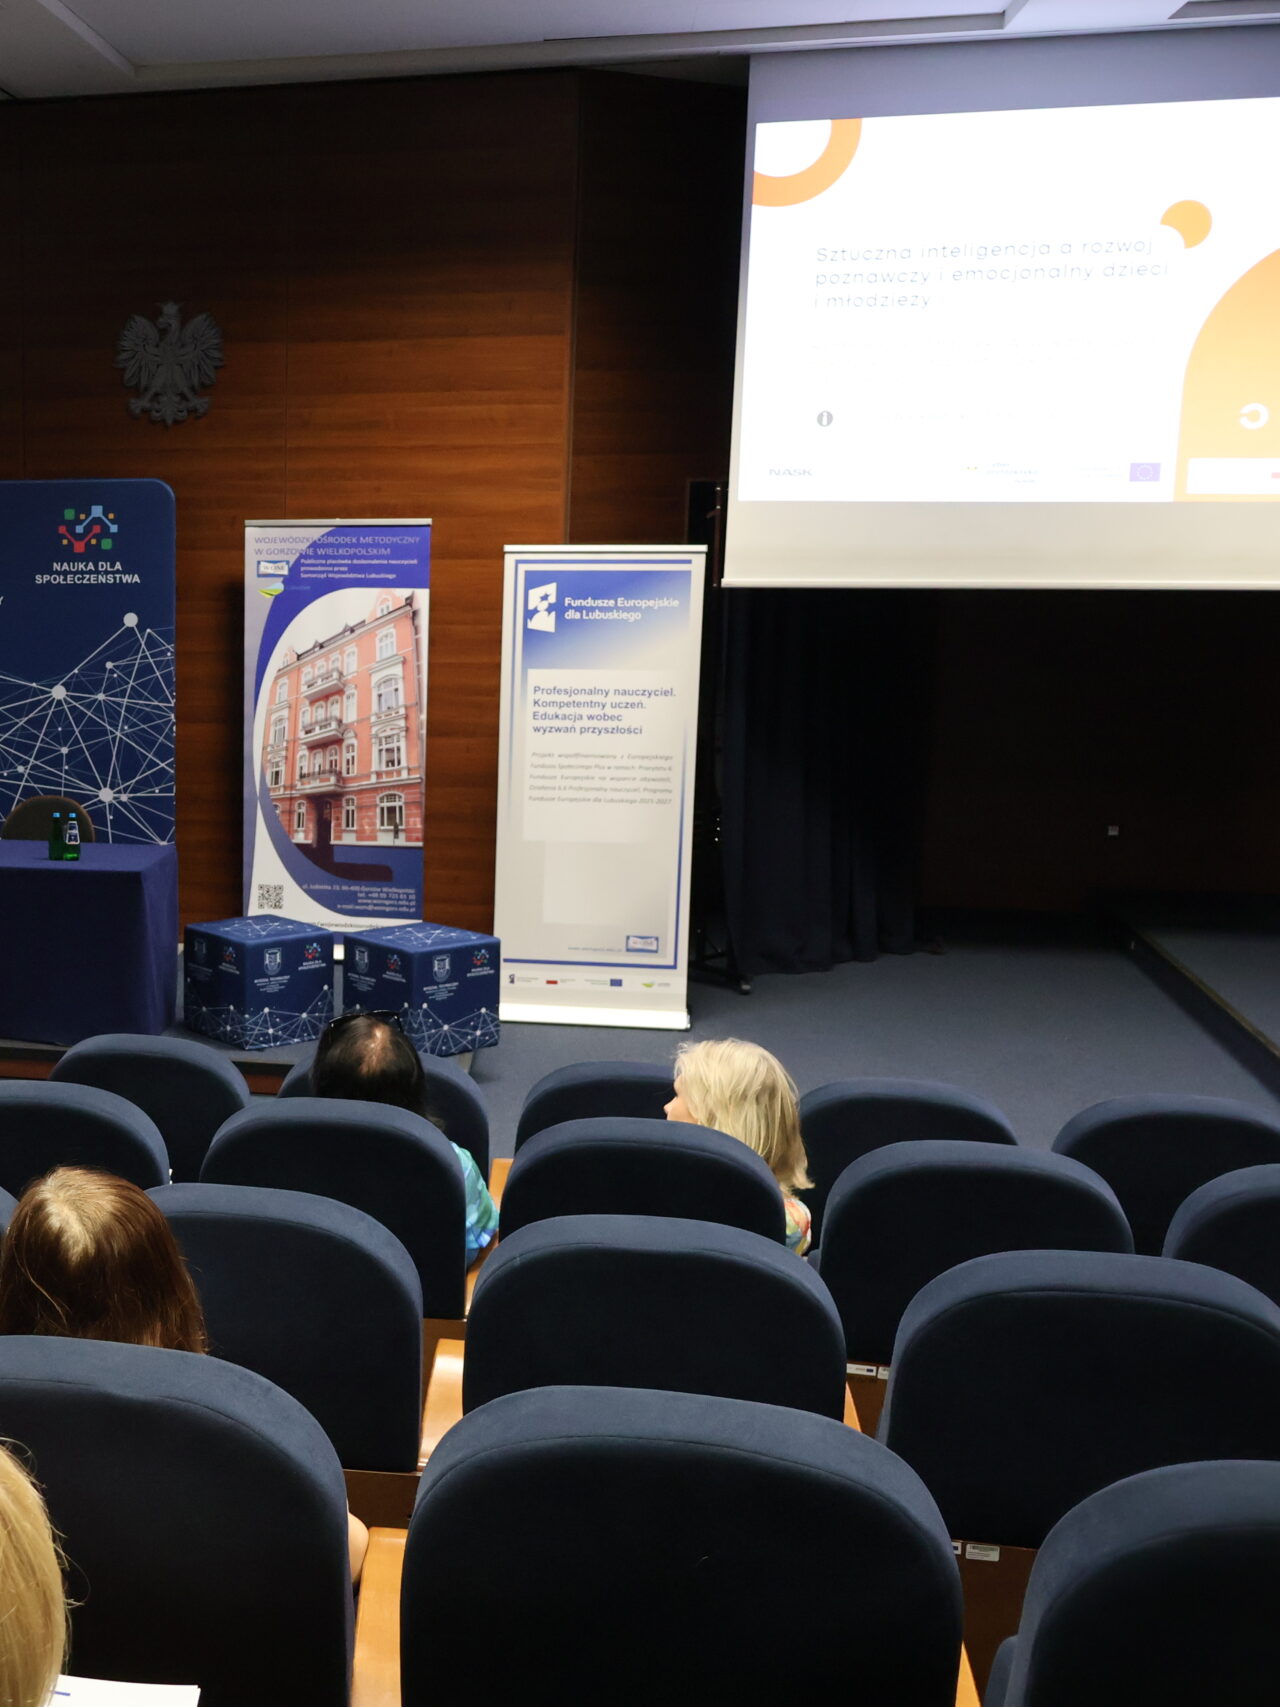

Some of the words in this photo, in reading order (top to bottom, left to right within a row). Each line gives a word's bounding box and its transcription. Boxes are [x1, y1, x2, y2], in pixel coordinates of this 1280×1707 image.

[816, 246, 912, 263] Sztuczna
[920, 240, 1051, 260] inteligencja
[1060, 242, 1072, 256] a
[816, 268, 931, 287] poznawczy
[952, 262, 1093, 283] emocjonalny
[1103, 261, 1169, 279] dzieci
[360, 536, 420, 544] METODYCZNY
[52, 562, 95, 571] NAUKA
[98, 561, 122, 571] DLA
[35, 572, 141, 584] SPOŁECZEŃSTWA
[564, 597, 616, 607] Fundusze
[617, 597, 680, 609] Europejskie
[564, 609, 580, 620] dla
[583, 609, 641, 623] Lubuskiego
[533, 686, 610, 698] Profesjonalny
[614, 687, 676, 698] nauczyciel.
[533, 698, 607, 710] Kompetentny
[532, 712, 583, 723] Edukacja
[587, 712, 623, 721] wobec
[532, 724, 576, 735] wyzwań
[580, 725, 643, 736] przyszłości
